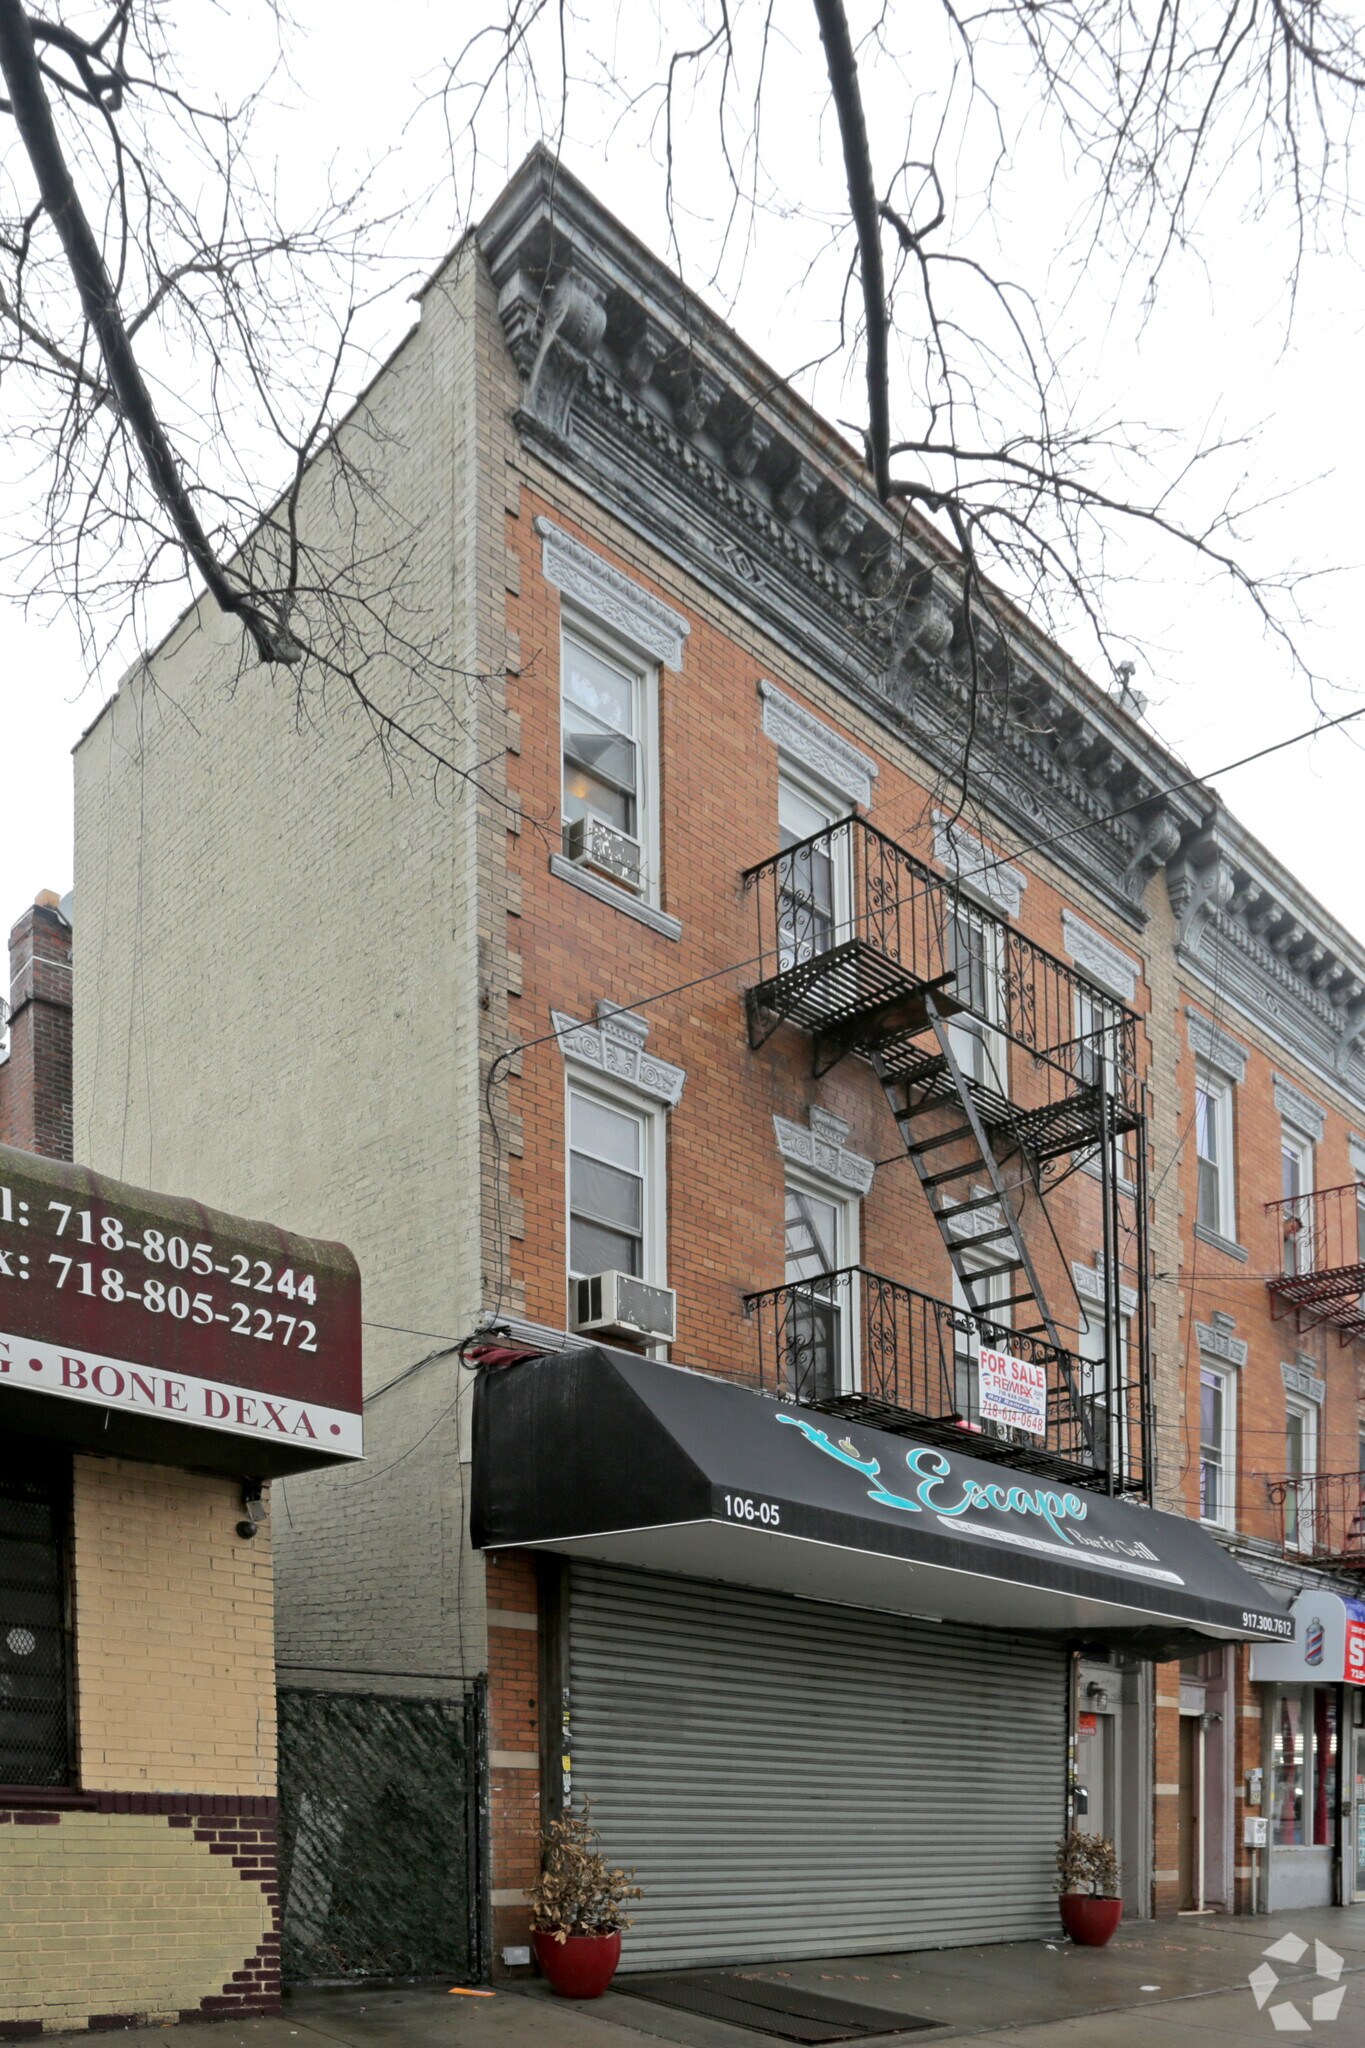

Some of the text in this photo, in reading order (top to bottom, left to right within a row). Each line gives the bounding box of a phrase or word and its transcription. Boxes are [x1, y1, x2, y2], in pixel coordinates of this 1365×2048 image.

[48, 1201, 317, 1305] 718-805-2244
[48, 1254, 318, 1352] 718-805-2272
[980, 1350, 1045, 1388] FOR SALE
[58, 1355, 189, 1413] BONE
[201, 1387, 319, 1439] DEXA
[982, 1400, 1043, 1432] 718-614-0648
[724, 1495, 780, 1525] 106-05
[906, 1448, 1087, 1545] Escape
[1065, 1527, 1105, 1549] Bar
[1115, 1540, 1160, 1561] Grill
[1242, 1612, 1291, 1635] 917.300.7612
